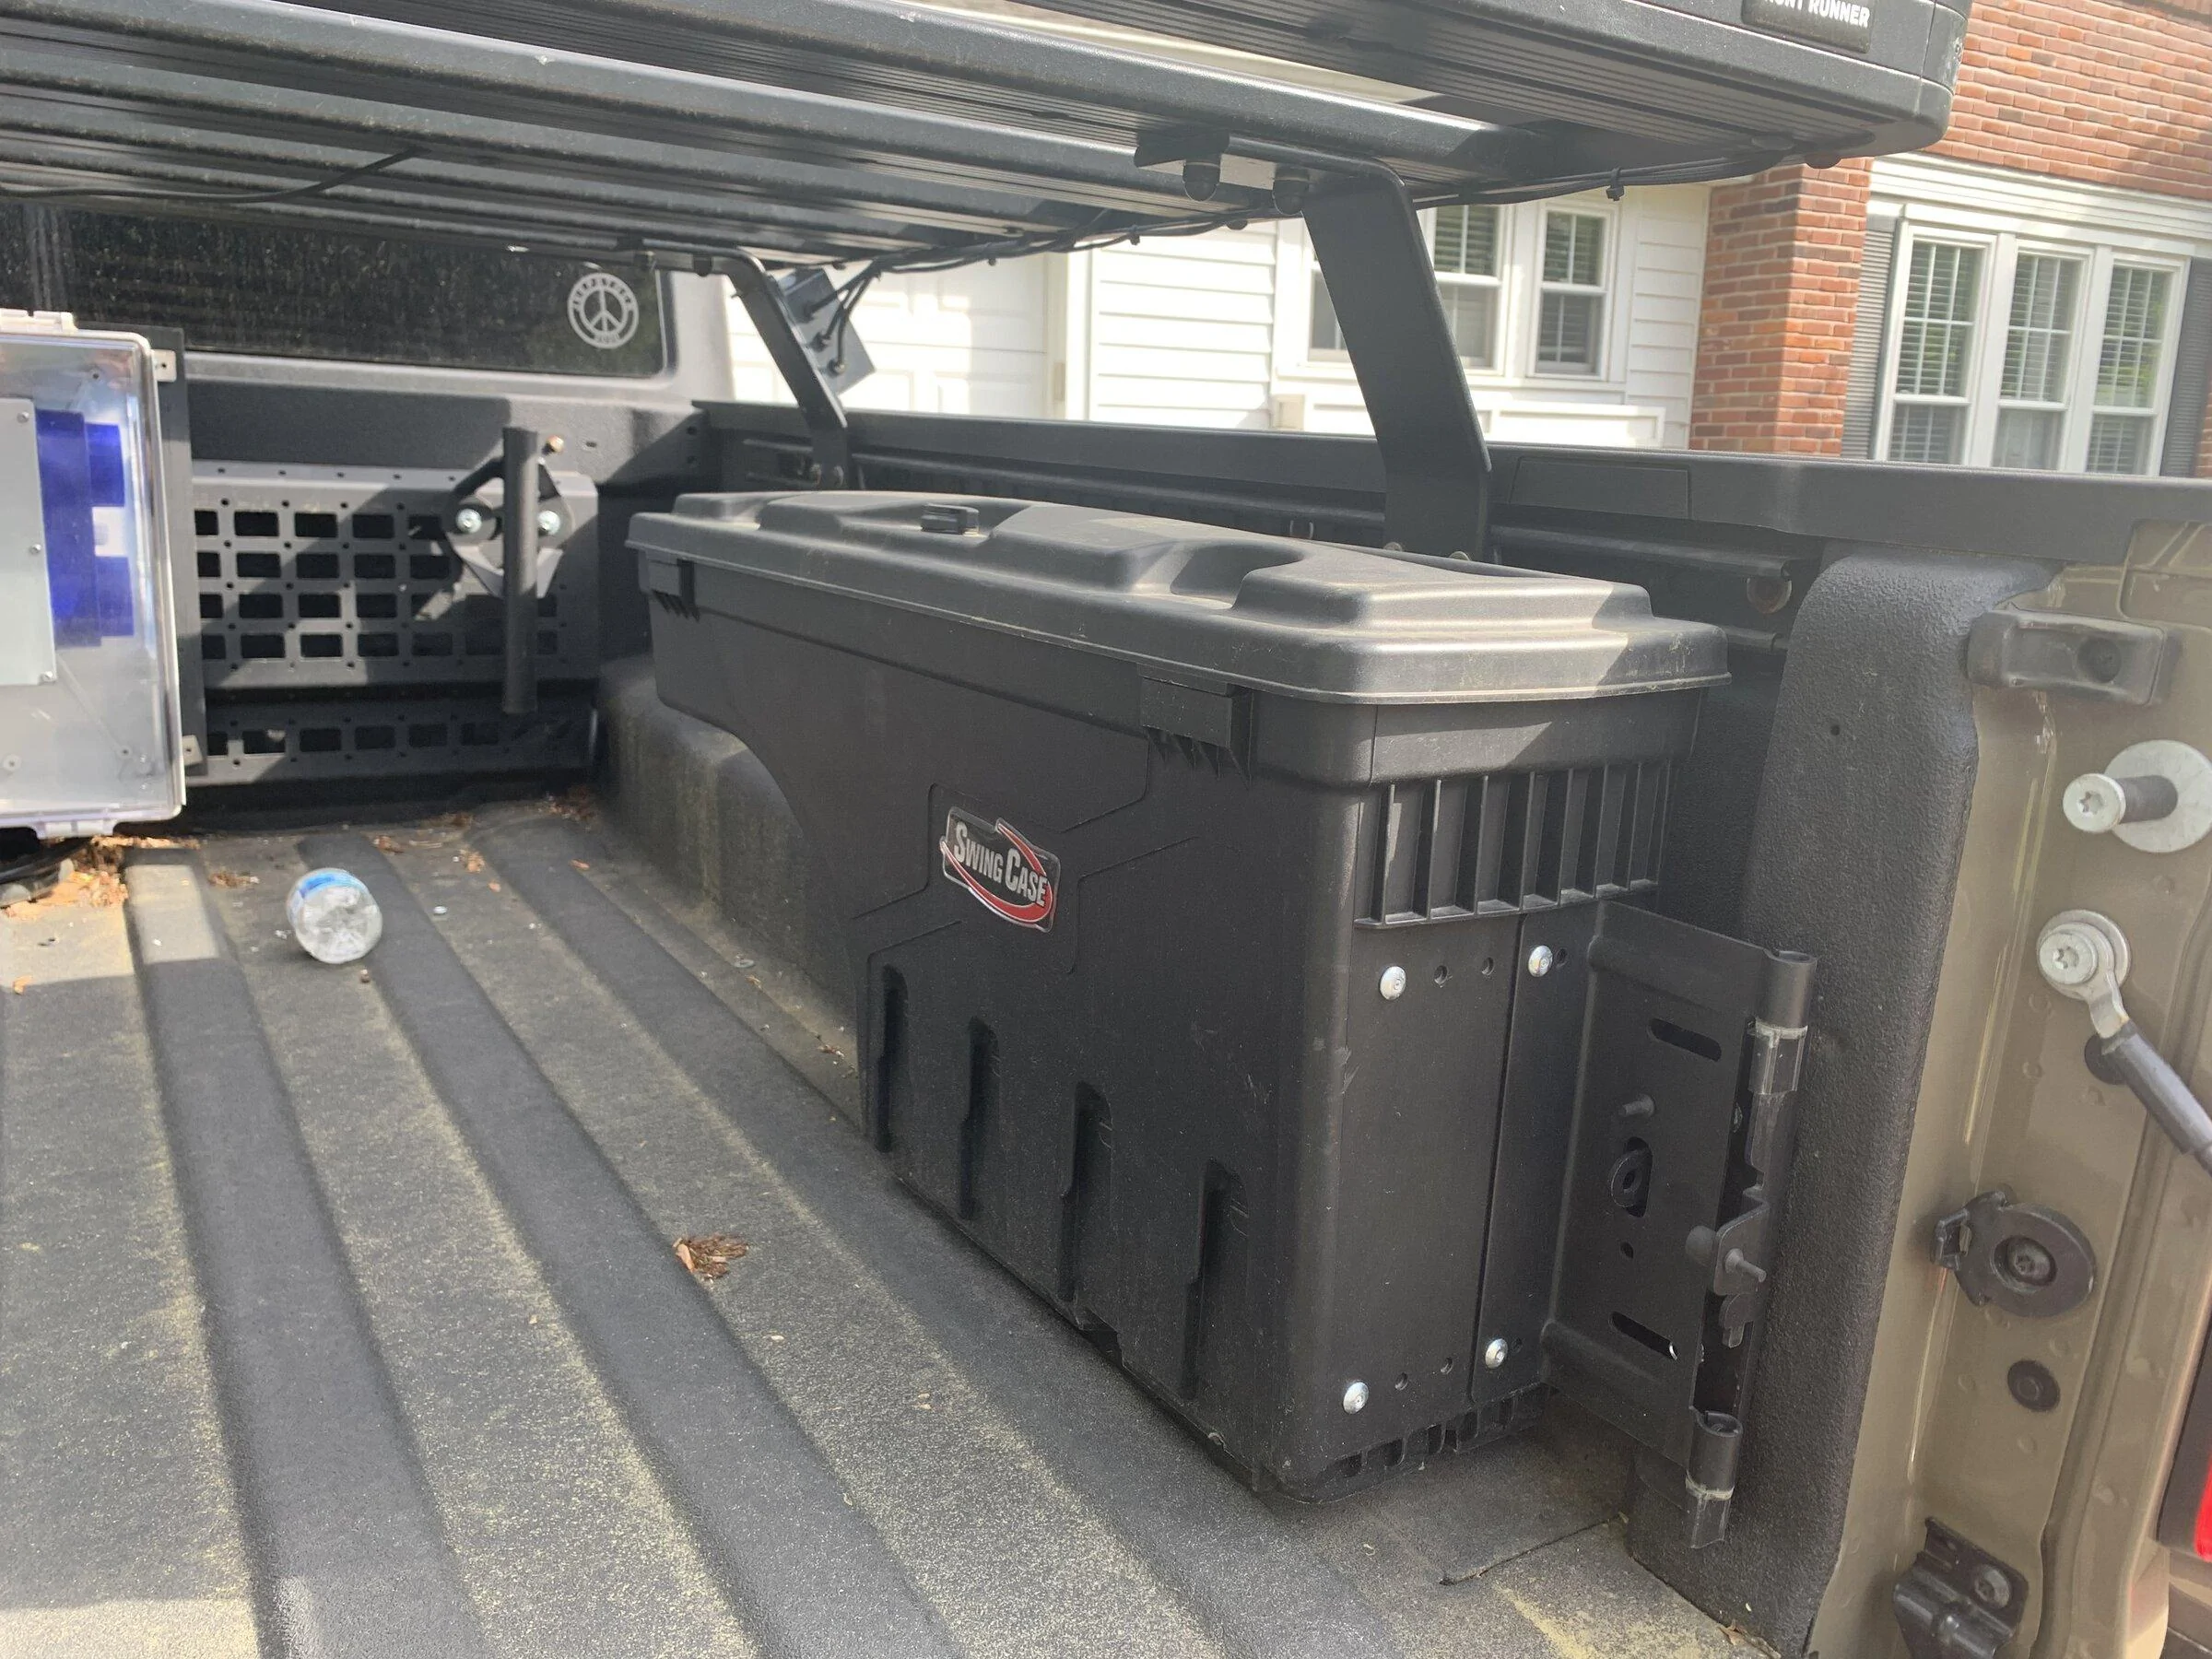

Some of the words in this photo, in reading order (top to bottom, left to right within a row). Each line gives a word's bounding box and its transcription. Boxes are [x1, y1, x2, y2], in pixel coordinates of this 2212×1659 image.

[1808, 0, 1870, 28] RUNNER
[953, 821, 1004, 884] SWING
[1005, 848, 1049, 907] CASE
